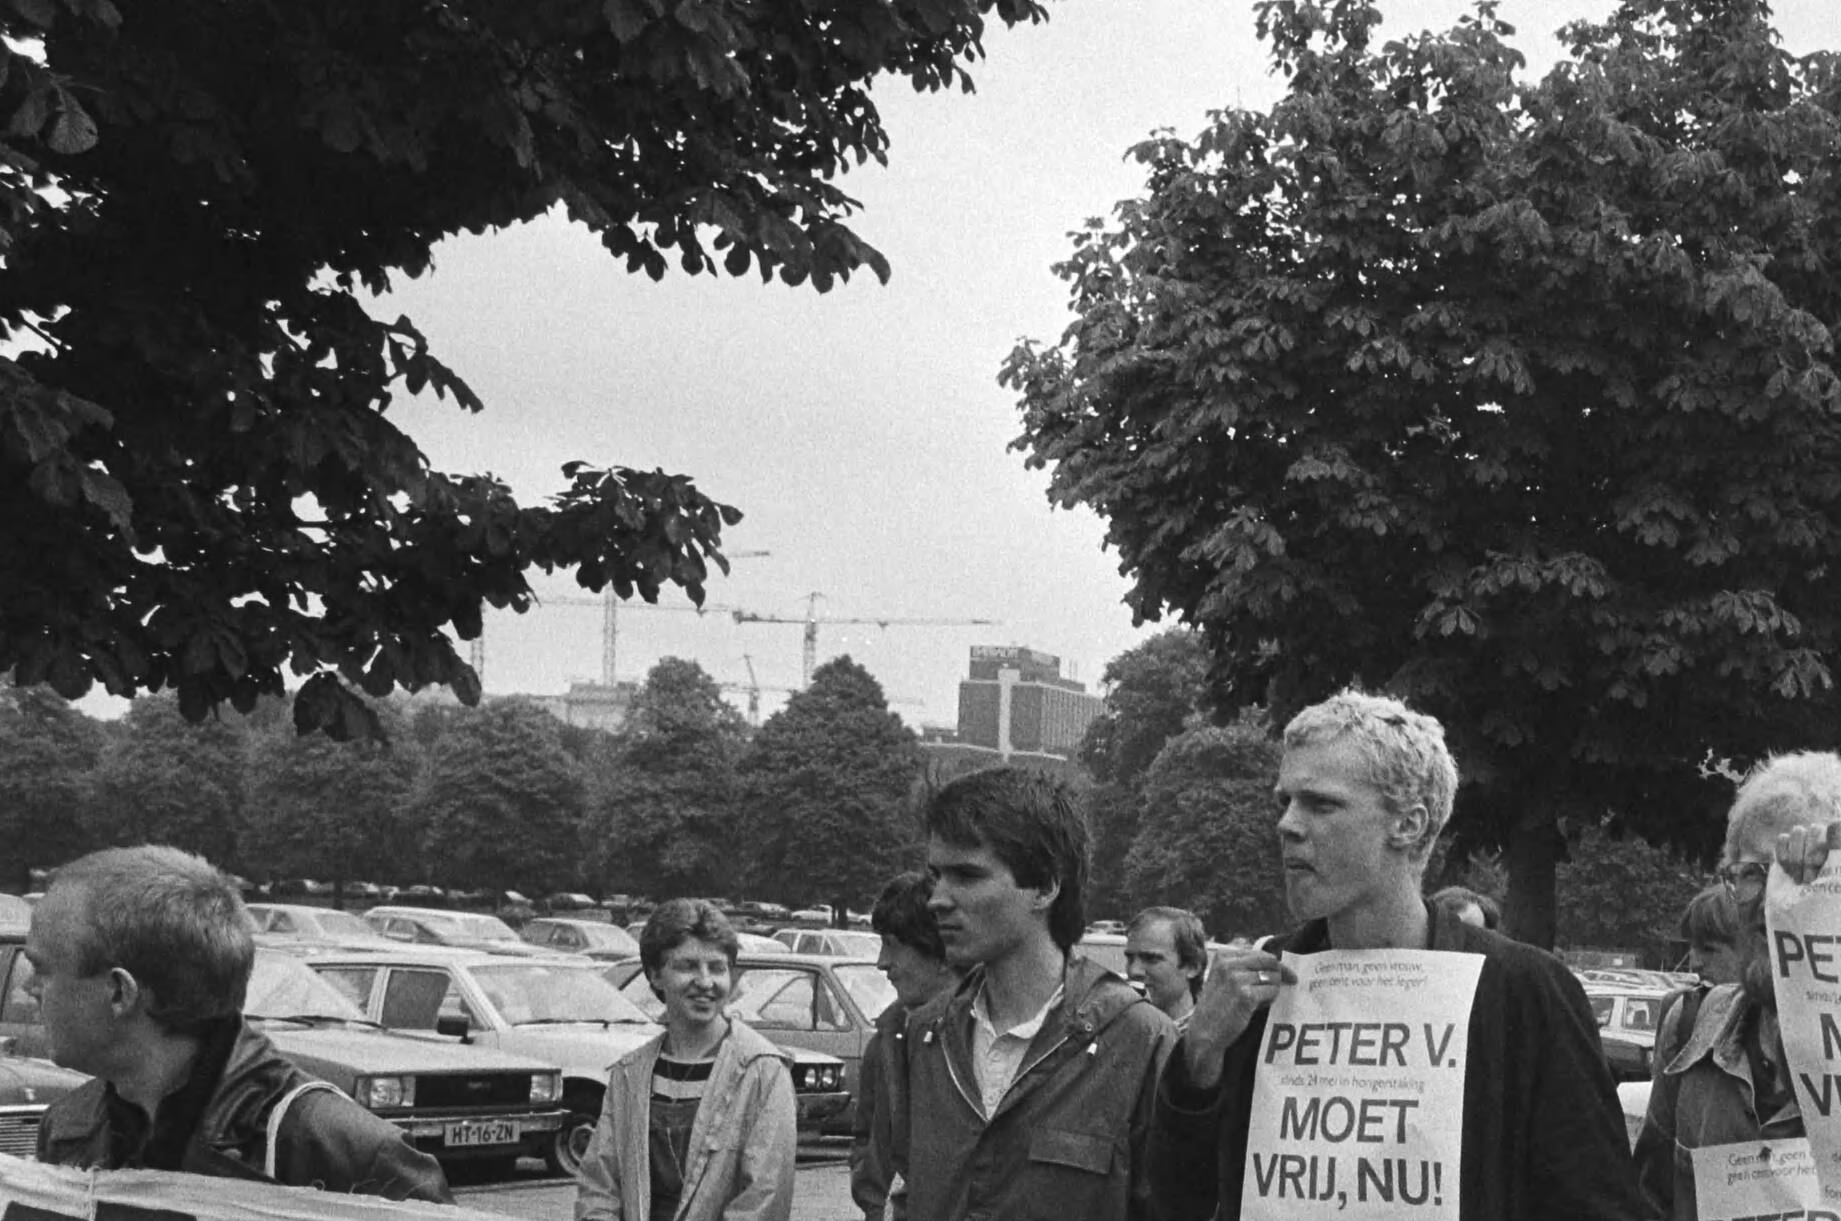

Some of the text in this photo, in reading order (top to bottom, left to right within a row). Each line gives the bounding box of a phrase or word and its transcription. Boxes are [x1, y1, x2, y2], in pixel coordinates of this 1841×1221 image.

[1264, 1021, 1457, 1069] PETER V.
[452, 1123, 514, 1145] HT-16-ZN
[1279, 1095, 1420, 1144] MOET
[1253, 1152, 1443, 1211] VRIJ, NU!
